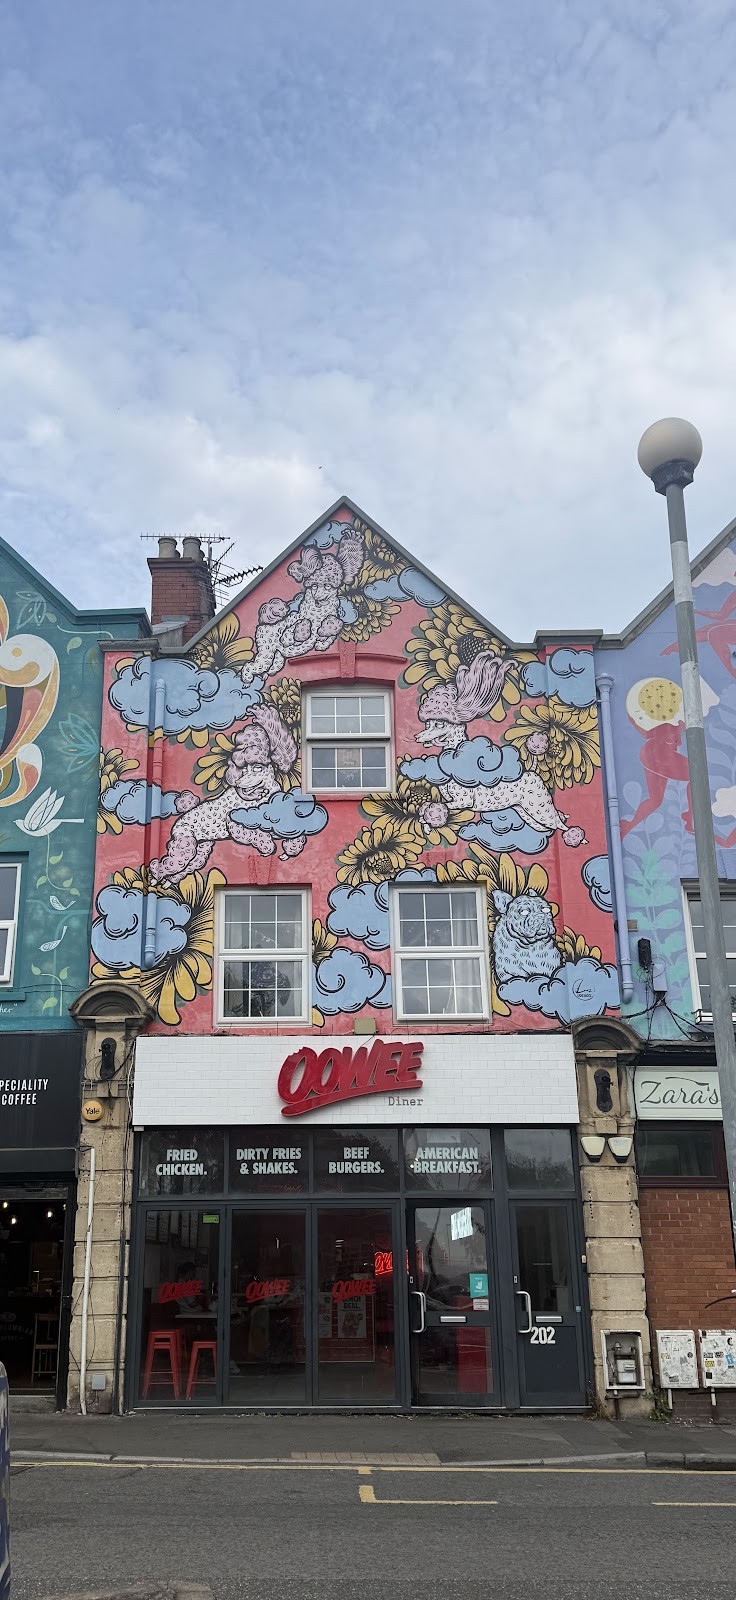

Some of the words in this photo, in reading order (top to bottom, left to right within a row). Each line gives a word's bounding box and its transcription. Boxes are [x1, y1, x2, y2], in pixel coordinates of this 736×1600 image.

[278, 1039, 424, 1111] OOWEE
[0, 1079, 48, 1091] PECIALITY
[640, 1077, 719, 1104] Zara's
[2, 1093, 37, 1105] COFFEE
[388, 1096, 424, 1107] Diner
[166, 1149, 198, 1161] FRIED
[236, 1148, 269, 1160] DIRTY
[272, 1147, 302, 1160] FRIES
[343, 1147, 369, 1160] BEEF
[416, 1147, 478, 1160] AMERICAN
[155, 1163, 208, 1176] CHICKEN.
[239, 1162, 249, 1175] &
[252, 1162, 298, 1174] SHAKES.
[328, 1161, 385, 1174] BURGERS.
[413, 1161, 482, 1174] BREAKFAST.
[245, 1279, 290, 1304] OOWEE
[332, 1279, 376, 1304] OOWEE
[530, 1326, 556, 1345] 202
